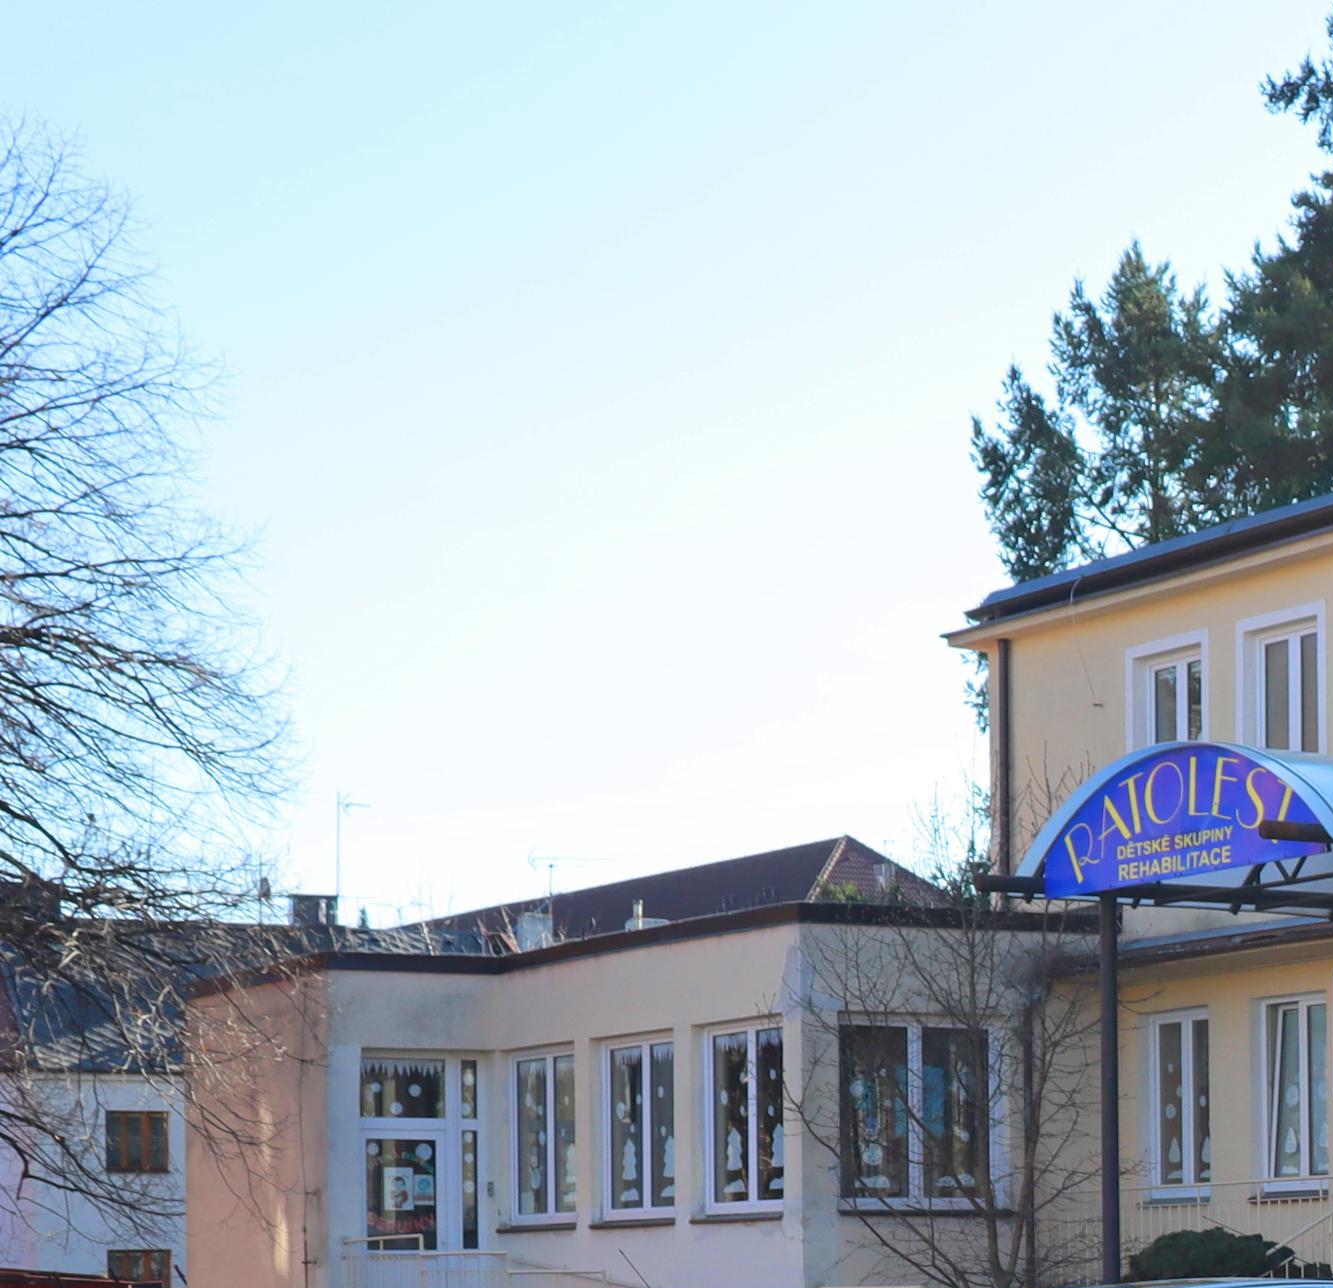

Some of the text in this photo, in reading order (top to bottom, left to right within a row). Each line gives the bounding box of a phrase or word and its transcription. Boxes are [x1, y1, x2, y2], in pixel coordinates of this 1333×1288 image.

[1064, 756, 1293, 884] RATOLEST
[1117, 826, 1233, 860] DĚTSKÉ SKUPINY
[1118, 845, 1232, 881] REHABILITACE
